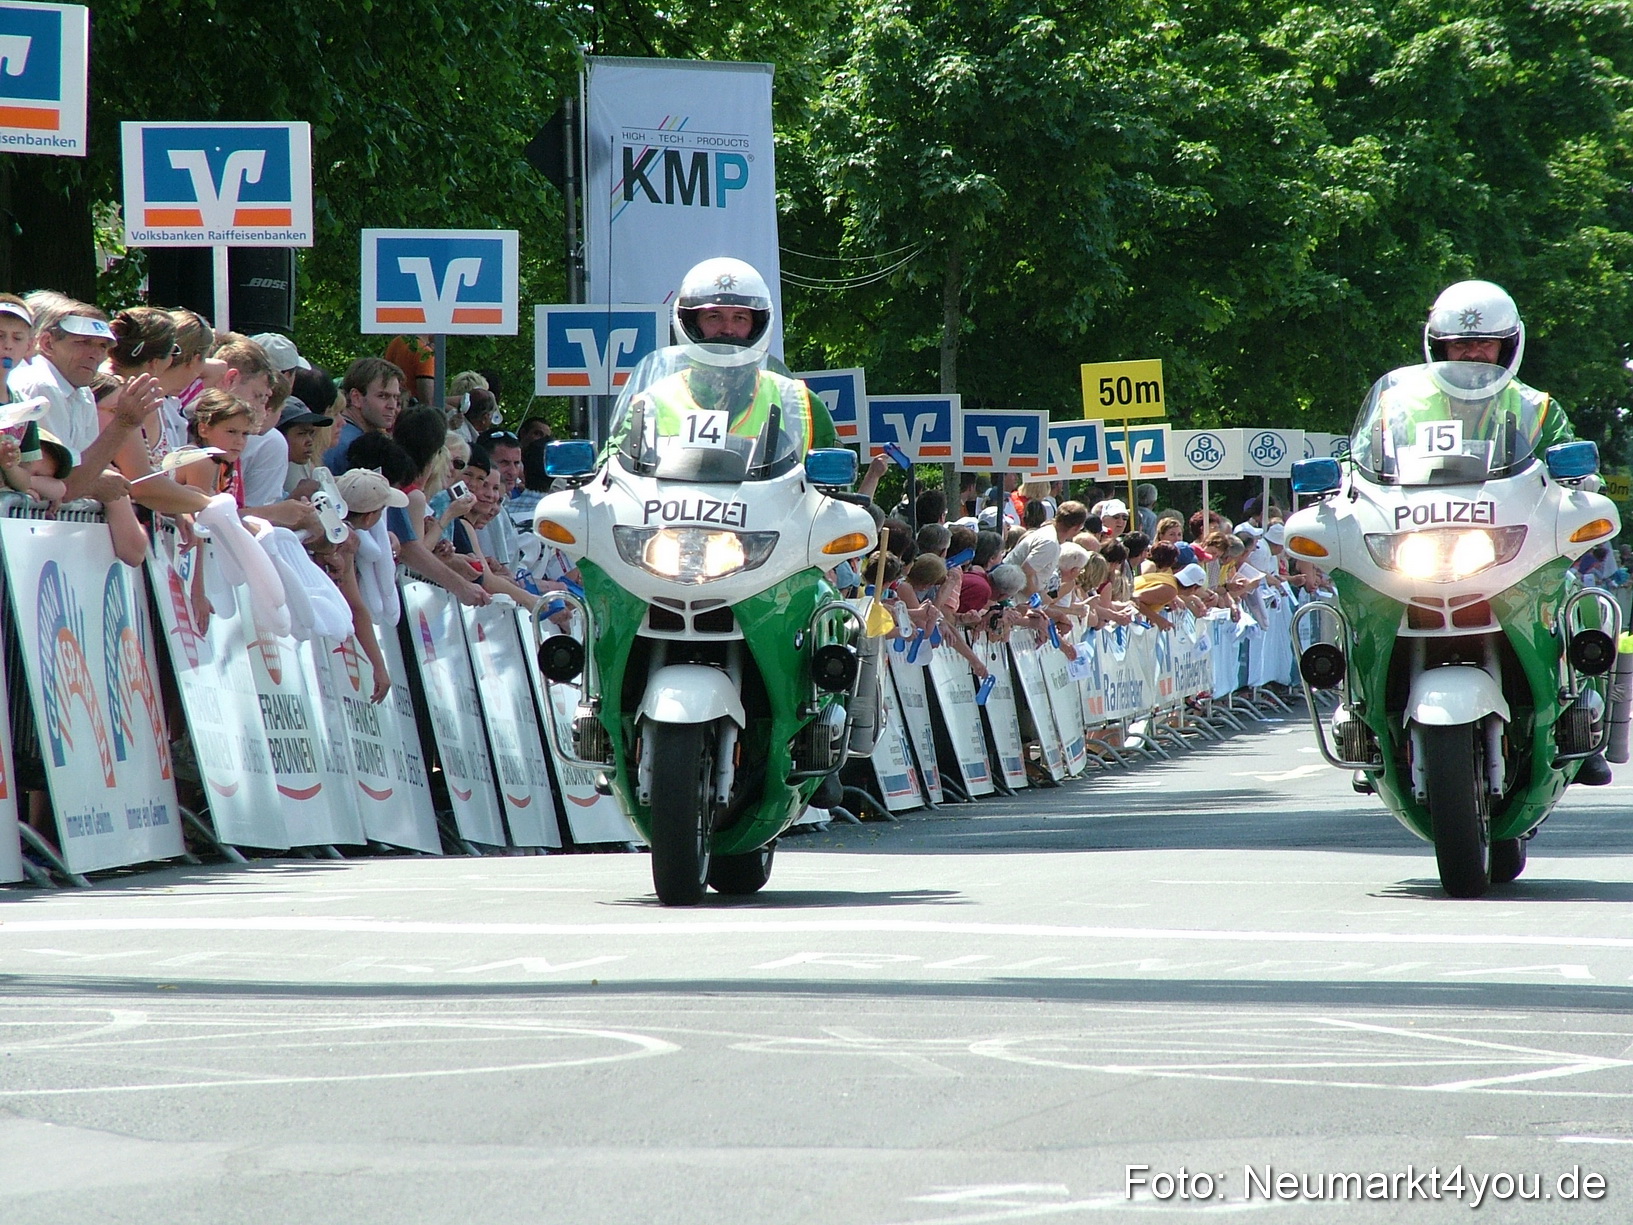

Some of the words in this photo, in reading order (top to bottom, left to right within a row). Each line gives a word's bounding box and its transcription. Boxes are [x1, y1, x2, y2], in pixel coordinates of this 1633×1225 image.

[622, 131, 646, 142] HIGH
[658, 134, 684, 144] TECH
[696, 136, 750, 148] PRODUCTS
[622, 146, 749, 209] KMP
[131, 230, 205, 241] Volksbanken
[208, 230, 307, 241] Raiffeisenbanken
[249, 277, 289, 291] BOSE
[1099, 376, 1160, 406] 50m
[686, 414, 721, 444] 14
[1424, 425, 1456, 452] 15
[1608, 482, 1629, 495] 0m
[644, 499, 748, 528] POLIZEI
[1394, 501, 1496, 530] POLIZEI
[258, 693, 308, 731] FRANKEN
[267, 737, 317, 775] BRUNNEN
